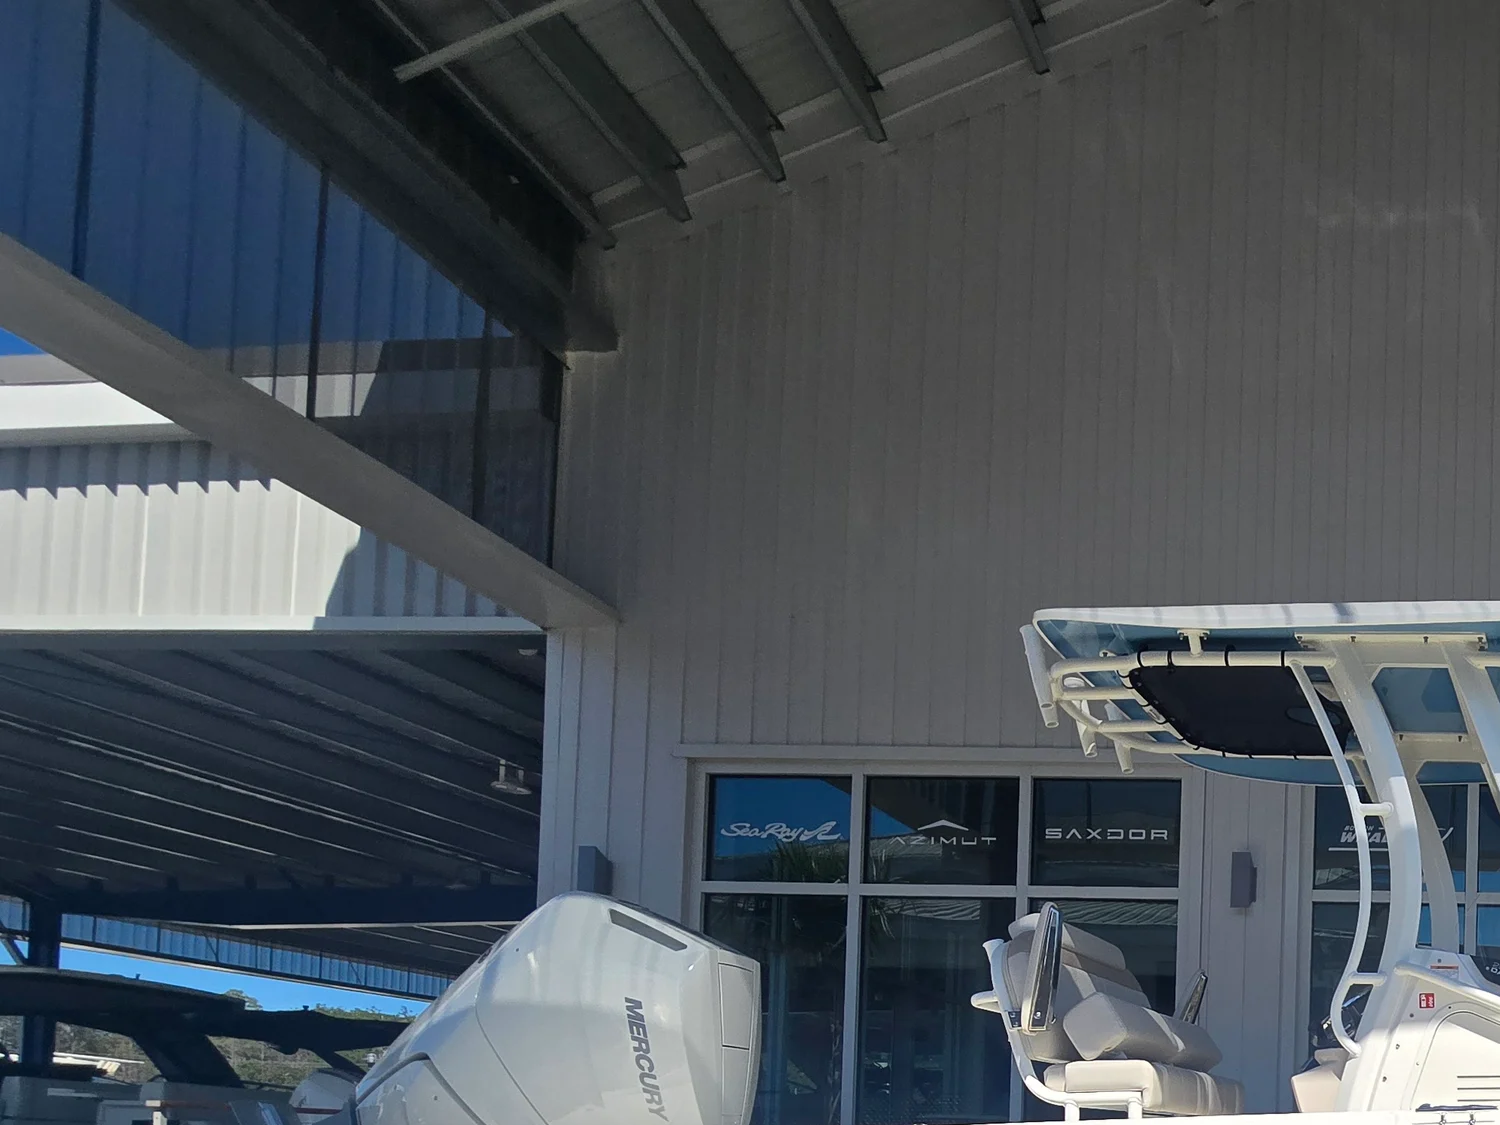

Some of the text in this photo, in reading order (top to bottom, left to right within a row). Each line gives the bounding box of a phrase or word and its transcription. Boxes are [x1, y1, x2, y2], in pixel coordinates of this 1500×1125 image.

[720, 822, 804, 842] Sea Ray
[1045, 828, 1169, 841] SAXDOR
[889, 836, 997, 846] AZIMUT
[624, 996, 670, 1122] MERCURY
